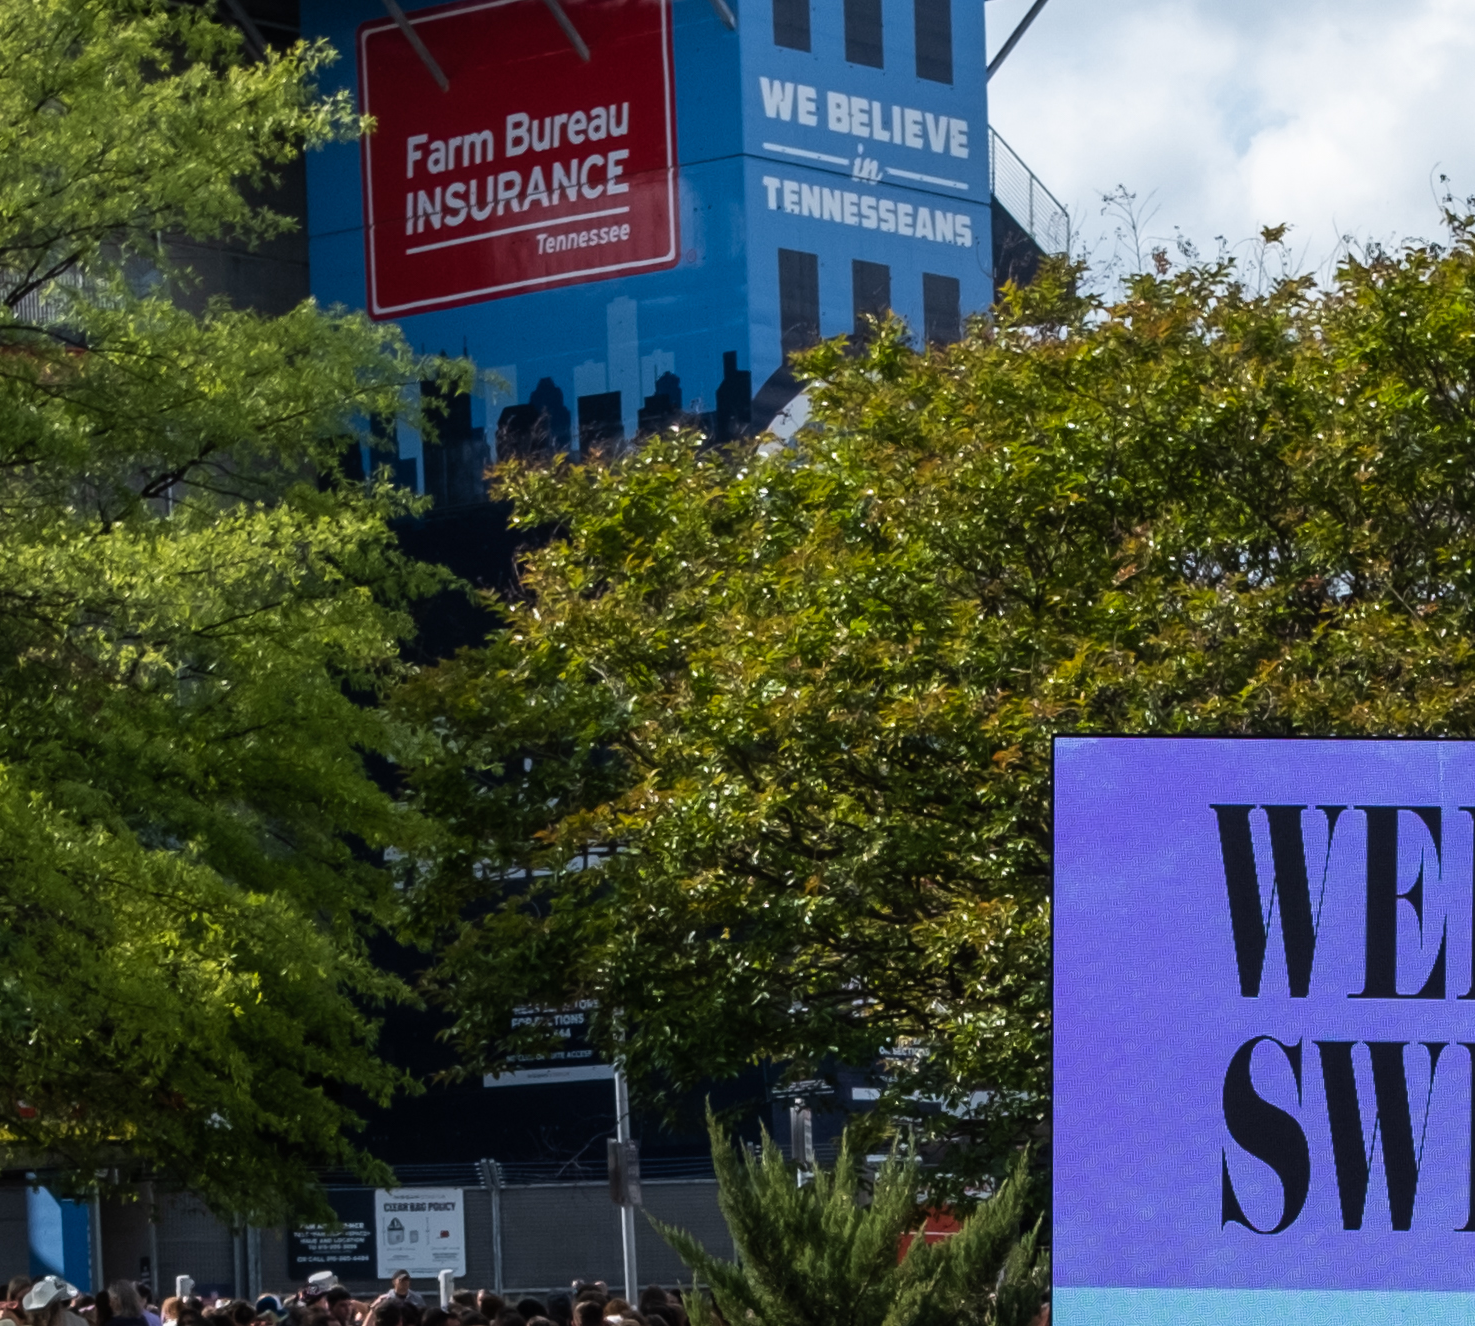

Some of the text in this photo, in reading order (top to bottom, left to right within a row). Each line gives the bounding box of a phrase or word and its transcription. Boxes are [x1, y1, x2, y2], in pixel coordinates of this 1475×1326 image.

[406, 102, 630, 180] Farm Bureau
[760, 76, 969, 159] WE BELIEVE
[406, 148, 630, 236] INSURANCE
[851, 143, 883, 185] in
[536, 222, 631, 256] Tennessee
[763, 175, 972, 248] TENNESSEANS
[384, 1202, 456, 1212] CLEAR BAG POLICY
